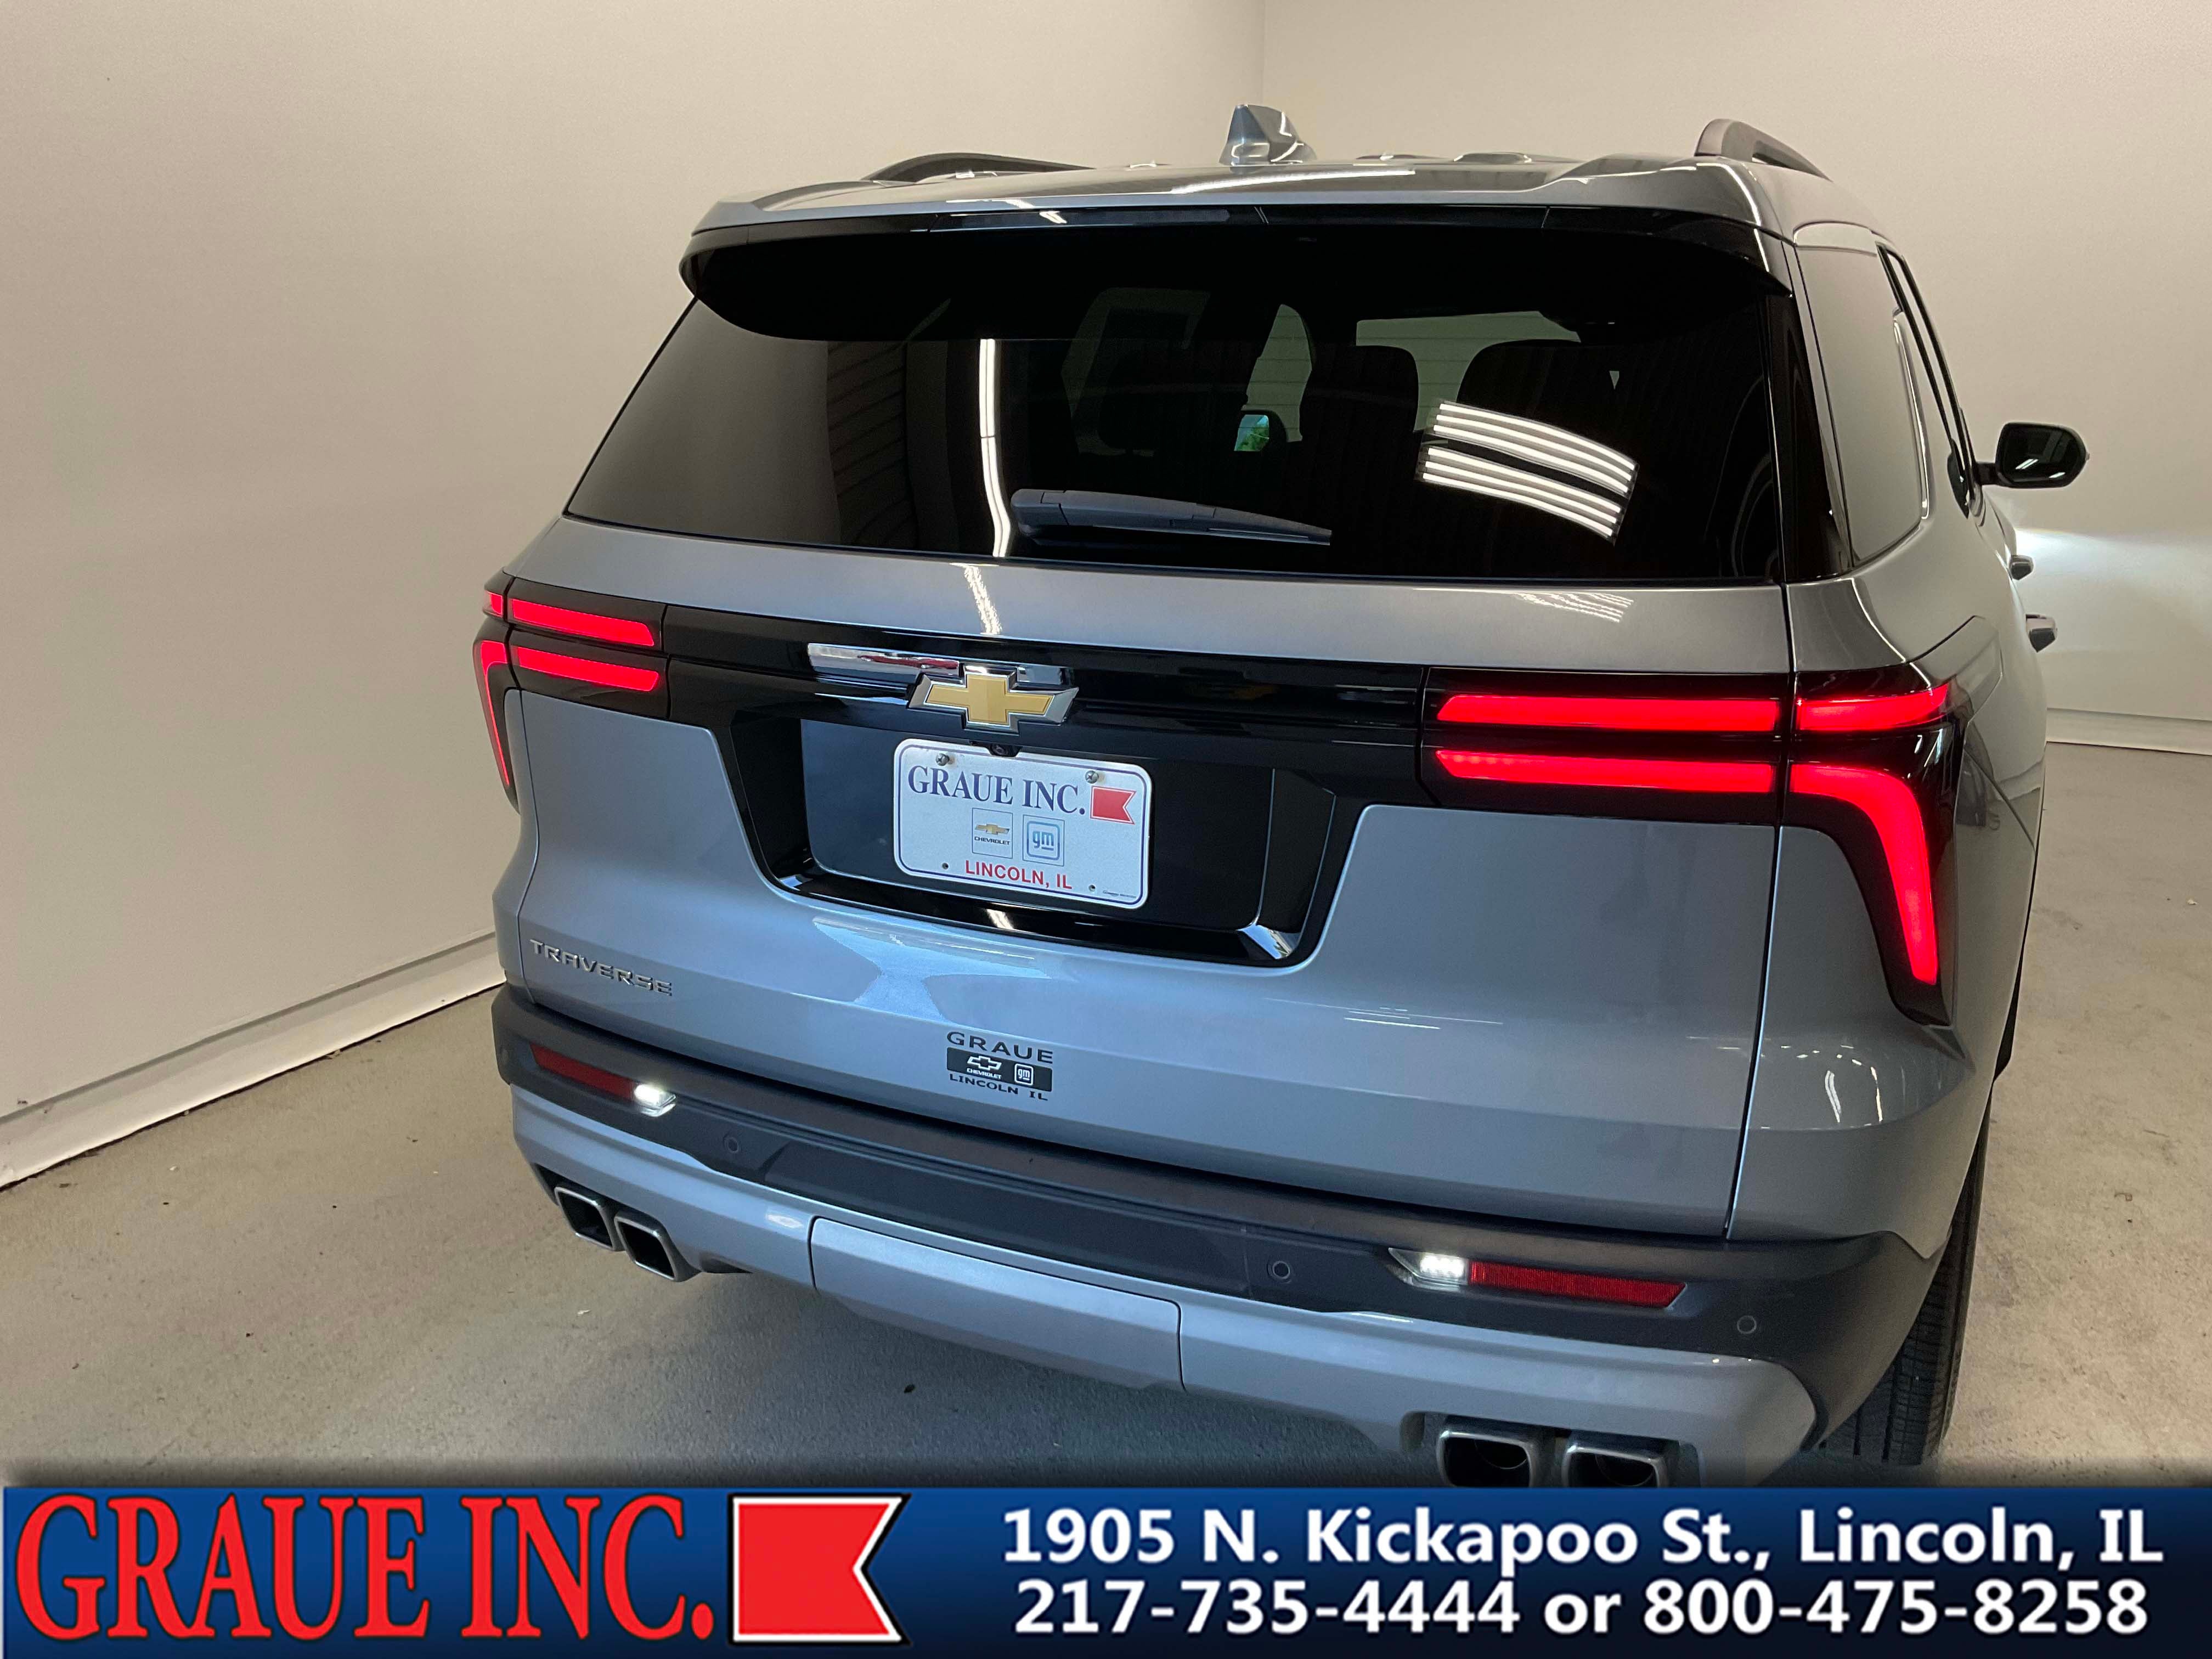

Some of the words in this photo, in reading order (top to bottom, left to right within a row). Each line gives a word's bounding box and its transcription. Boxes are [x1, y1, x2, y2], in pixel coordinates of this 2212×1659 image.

[908, 765, 1013, 805] GRAUE
[1022, 779, 1086, 815] INC.
[974, 836, 1011, 845] CHEVROLET
[1032, 830, 1055, 851] gm
[965, 860, 1049, 888] LINCOLN,
[1057, 874, 1073, 889] IL
[530, 939, 672, 996] TRAVERSE
[947, 1031, 1053, 1064] GRAUE
[967, 1068, 1001, 1079] CHEVROLET
[1018, 1068, 1030, 1080] gm
[950, 1074, 1018, 1094] LINCOLN
[1029, 1091, 1048, 1101] IL
